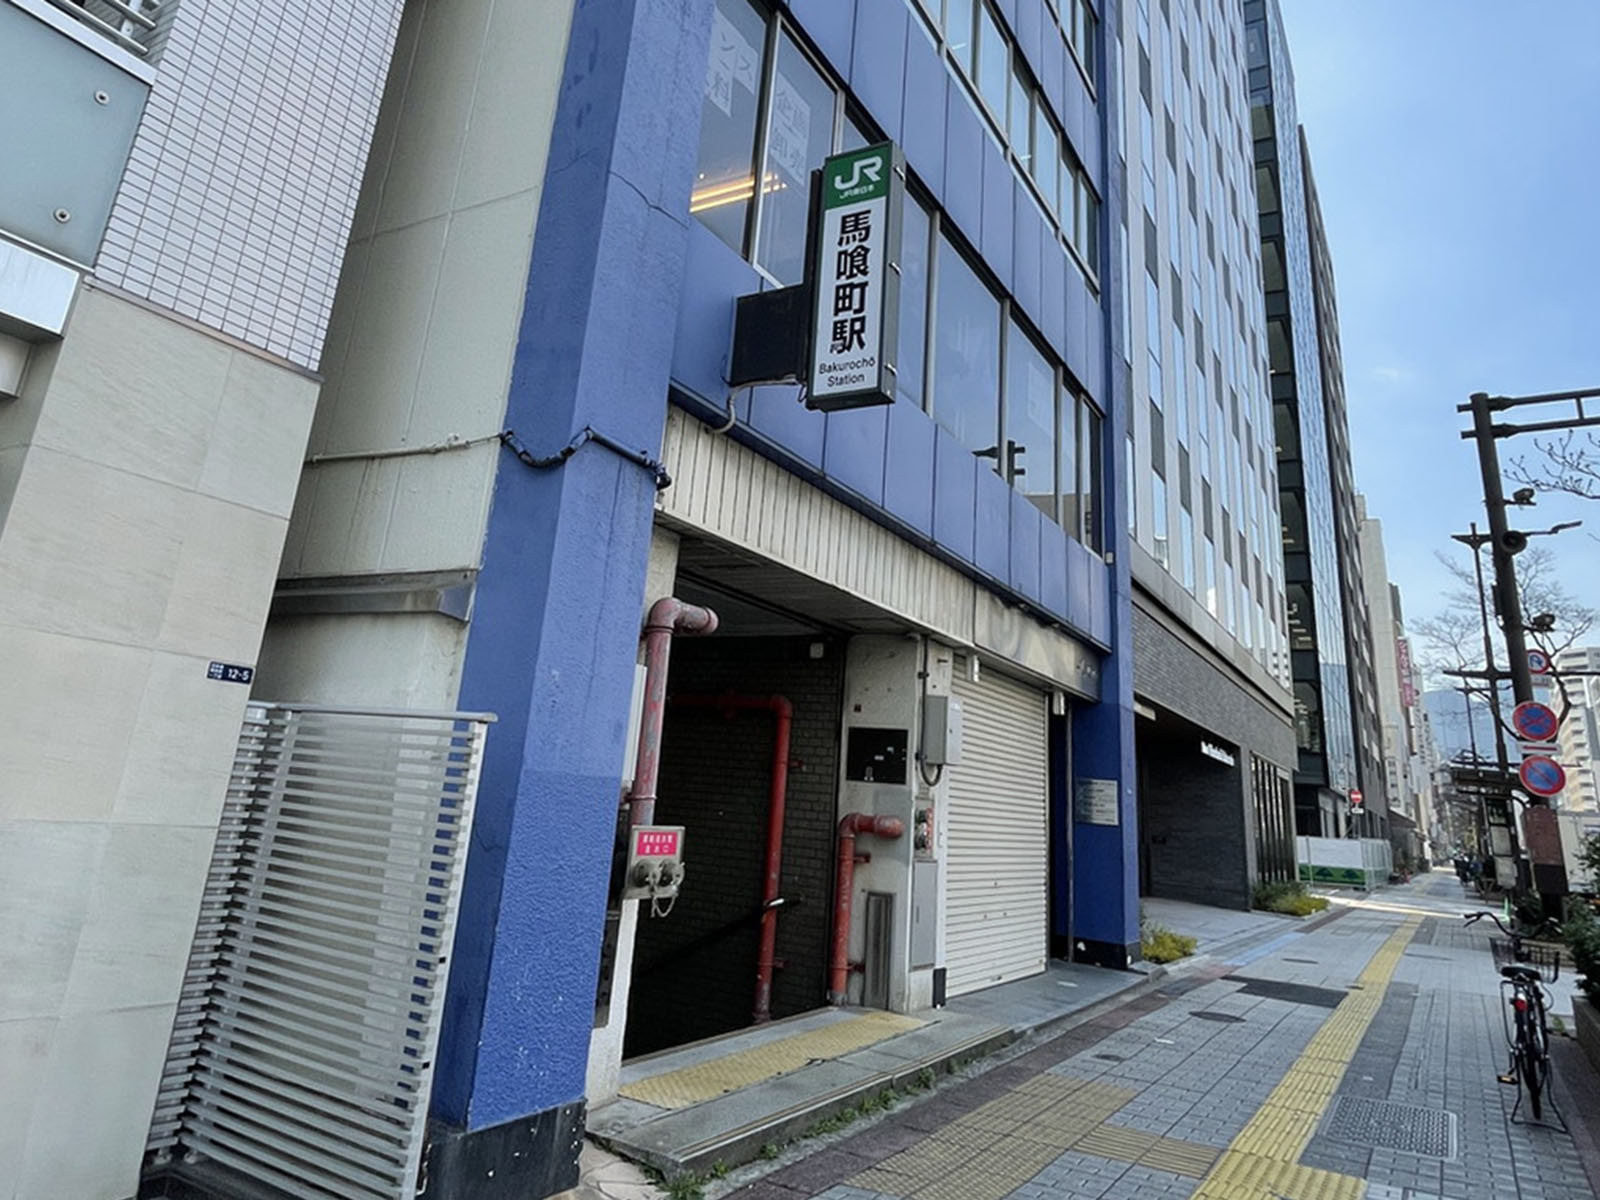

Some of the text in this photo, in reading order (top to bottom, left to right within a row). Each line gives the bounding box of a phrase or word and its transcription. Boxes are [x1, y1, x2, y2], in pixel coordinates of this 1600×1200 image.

[834, 155, 883, 190] JR
[829, 209, 872, 354] 馬喰町駅
[827, 374, 865, 387] Station
[228, 668, 249, 681] 12-5
